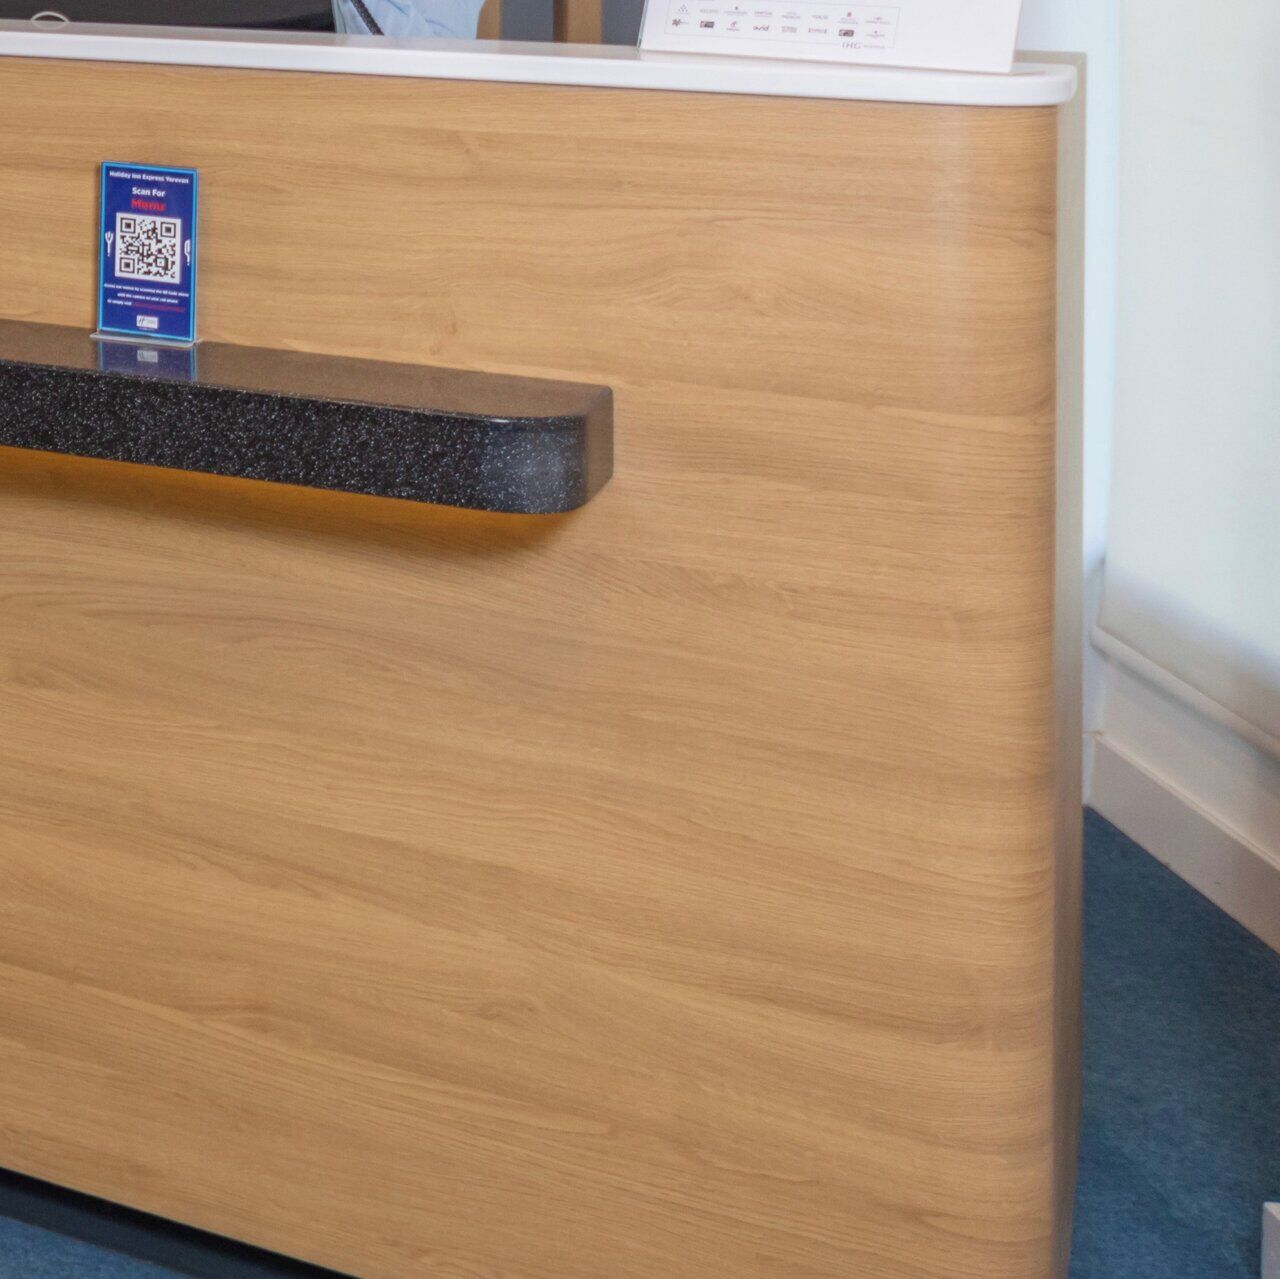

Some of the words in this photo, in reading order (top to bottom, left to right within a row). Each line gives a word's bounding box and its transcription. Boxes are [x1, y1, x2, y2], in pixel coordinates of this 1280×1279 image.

[109, 171, 131, 180] Holiday
[131, 172, 142, 180] Inn
[142, 174, 165, 182] Express
[132, 187, 151, 196] Scan
[152, 189, 166, 197] For
